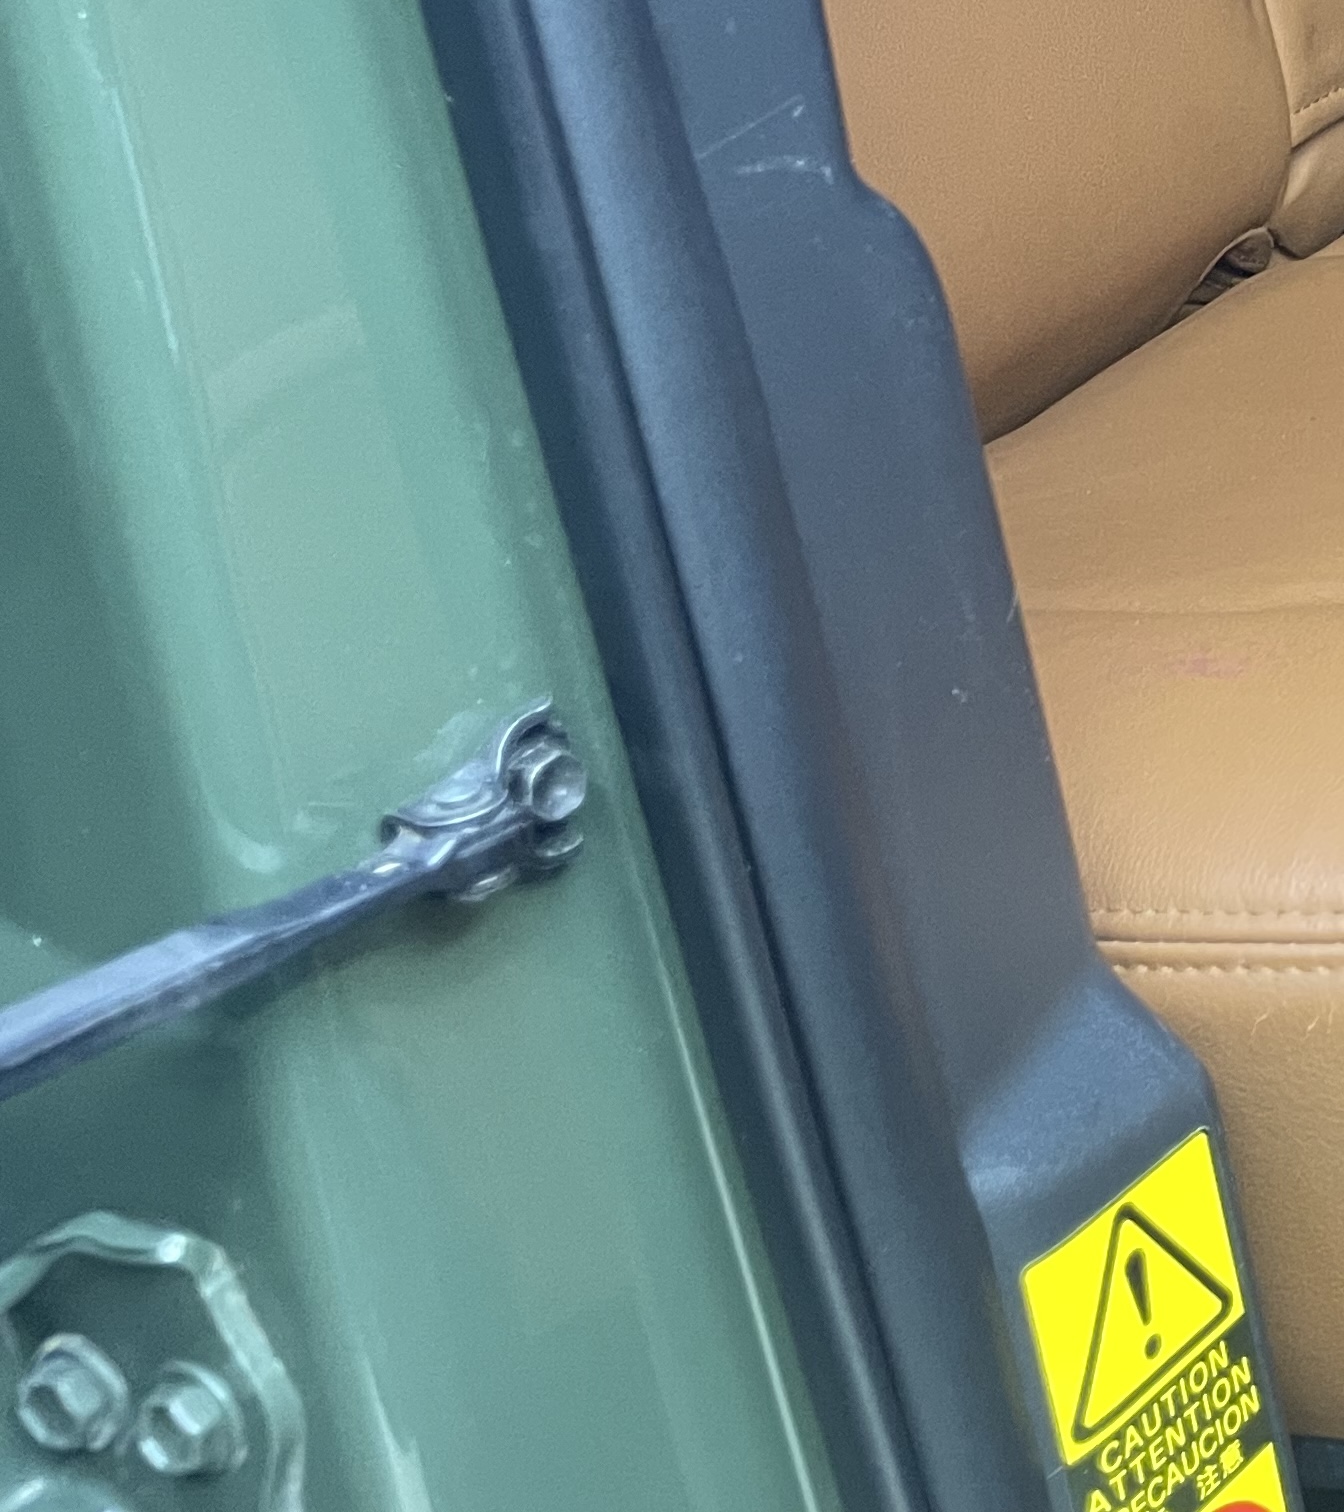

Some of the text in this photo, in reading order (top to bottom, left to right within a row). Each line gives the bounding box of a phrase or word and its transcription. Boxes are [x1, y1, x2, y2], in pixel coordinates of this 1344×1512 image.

[1088, 1356, 1252, 1512] ATTENTION
[1099, 1341, 1229, 1473] CAUTION
[1118, 1385, 1262, 1512] ECAUCION
